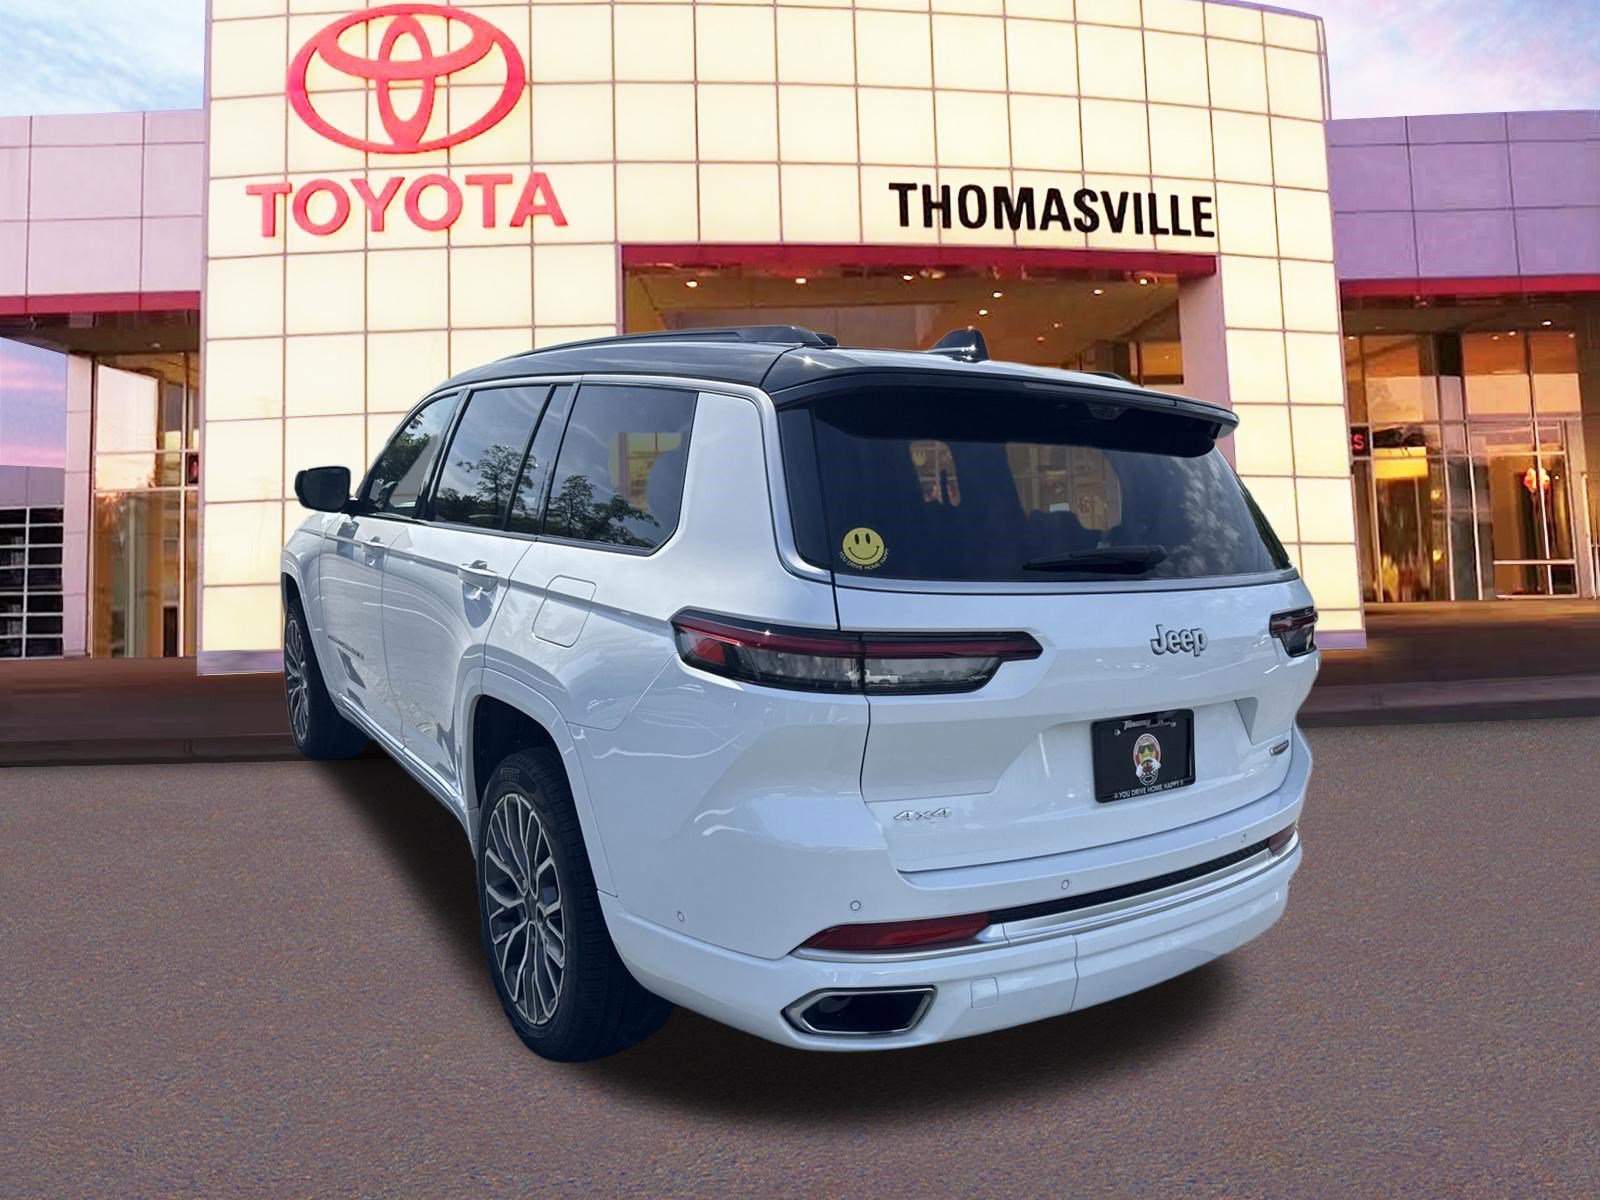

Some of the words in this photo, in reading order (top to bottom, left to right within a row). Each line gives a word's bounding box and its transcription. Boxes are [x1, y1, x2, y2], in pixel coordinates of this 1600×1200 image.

[246, 172, 568, 237] TOYOTA
[888, 182, 1216, 238] THOMASVILLE
[1150, 624, 1208, 657] Jeep
[1119, 790, 1131, 798] YOU
[1131, 787, 1147, 796] DRIVE
[1147, 784, 1163, 792] HOME
[1163, 780, 1180, 789] HAPPY
[893, 807, 953, 821] 4x4
